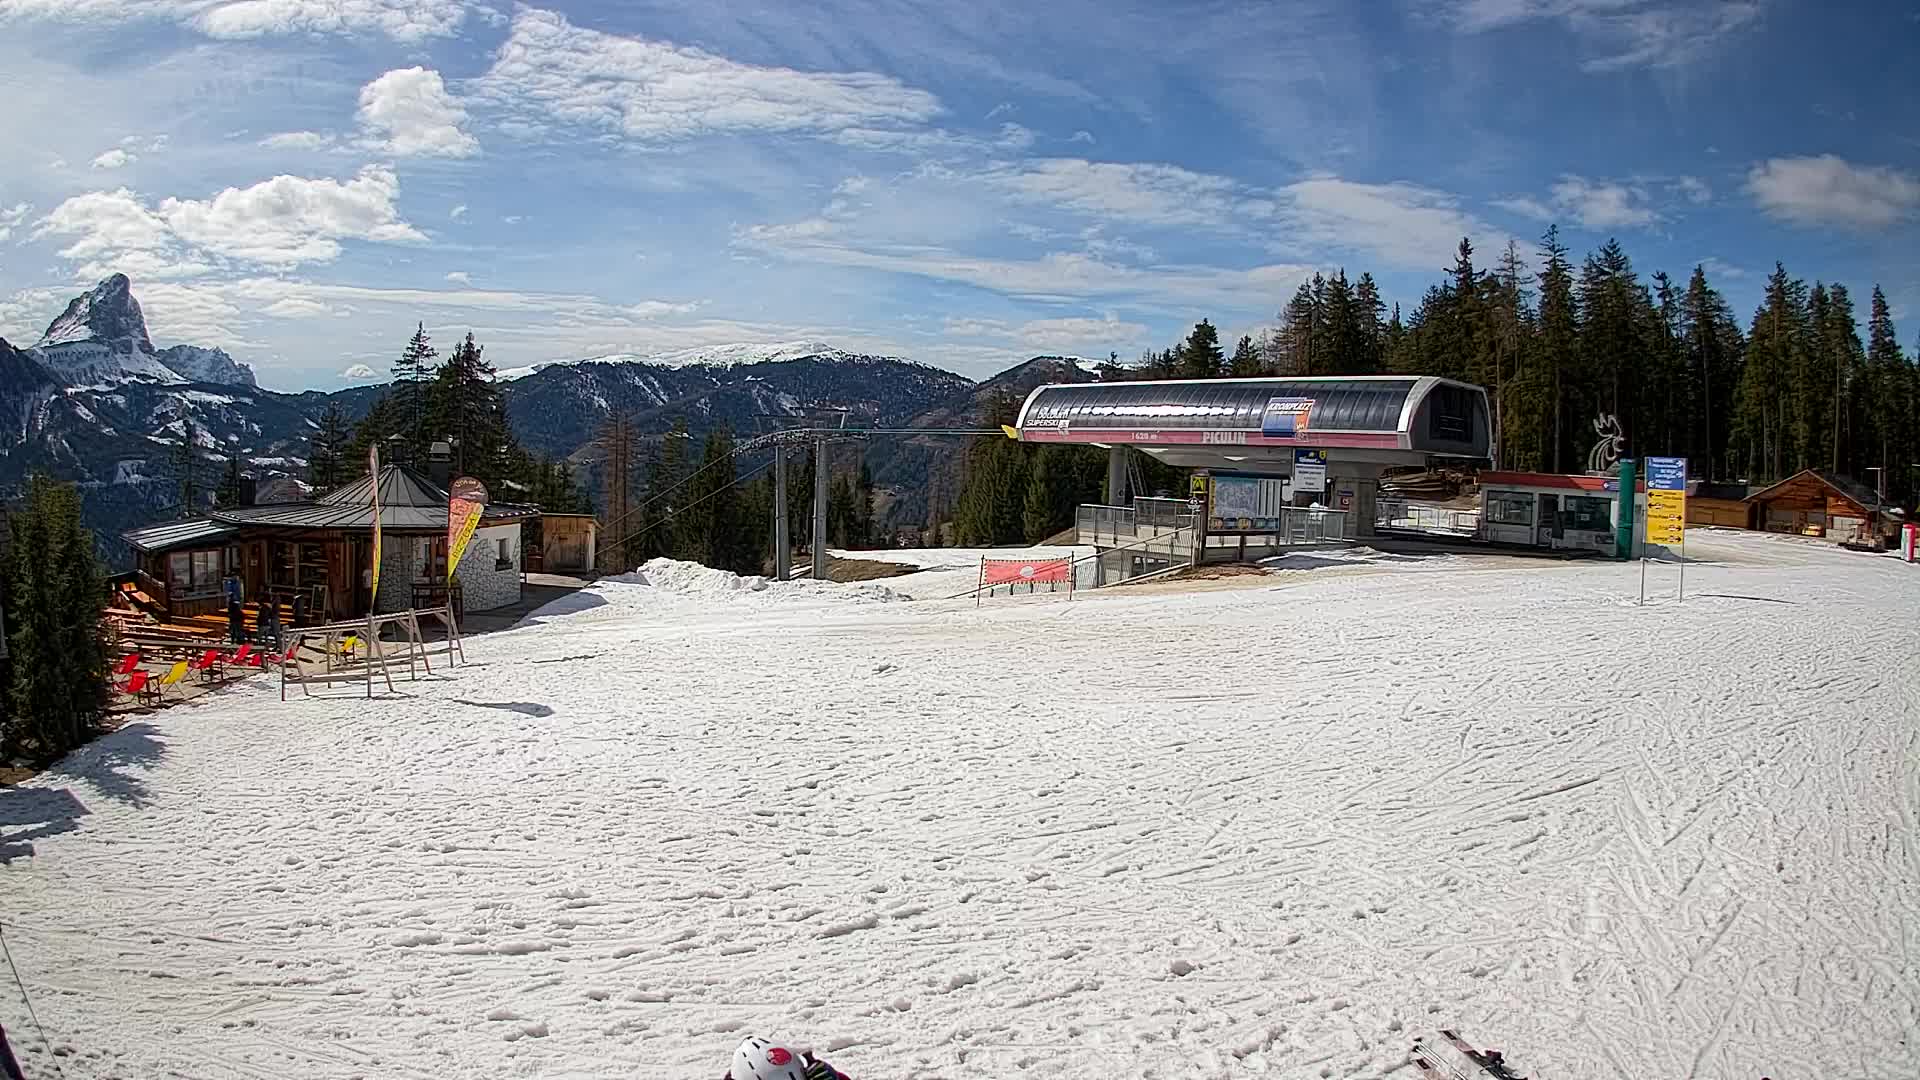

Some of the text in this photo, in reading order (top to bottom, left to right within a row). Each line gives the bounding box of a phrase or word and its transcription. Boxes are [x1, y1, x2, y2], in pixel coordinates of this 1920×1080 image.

[1267, 402, 1313, 411] KRONPLATZ
[1202, 431, 1246, 444] PICULIN
[452, 517, 477, 558] PIZZERIA
